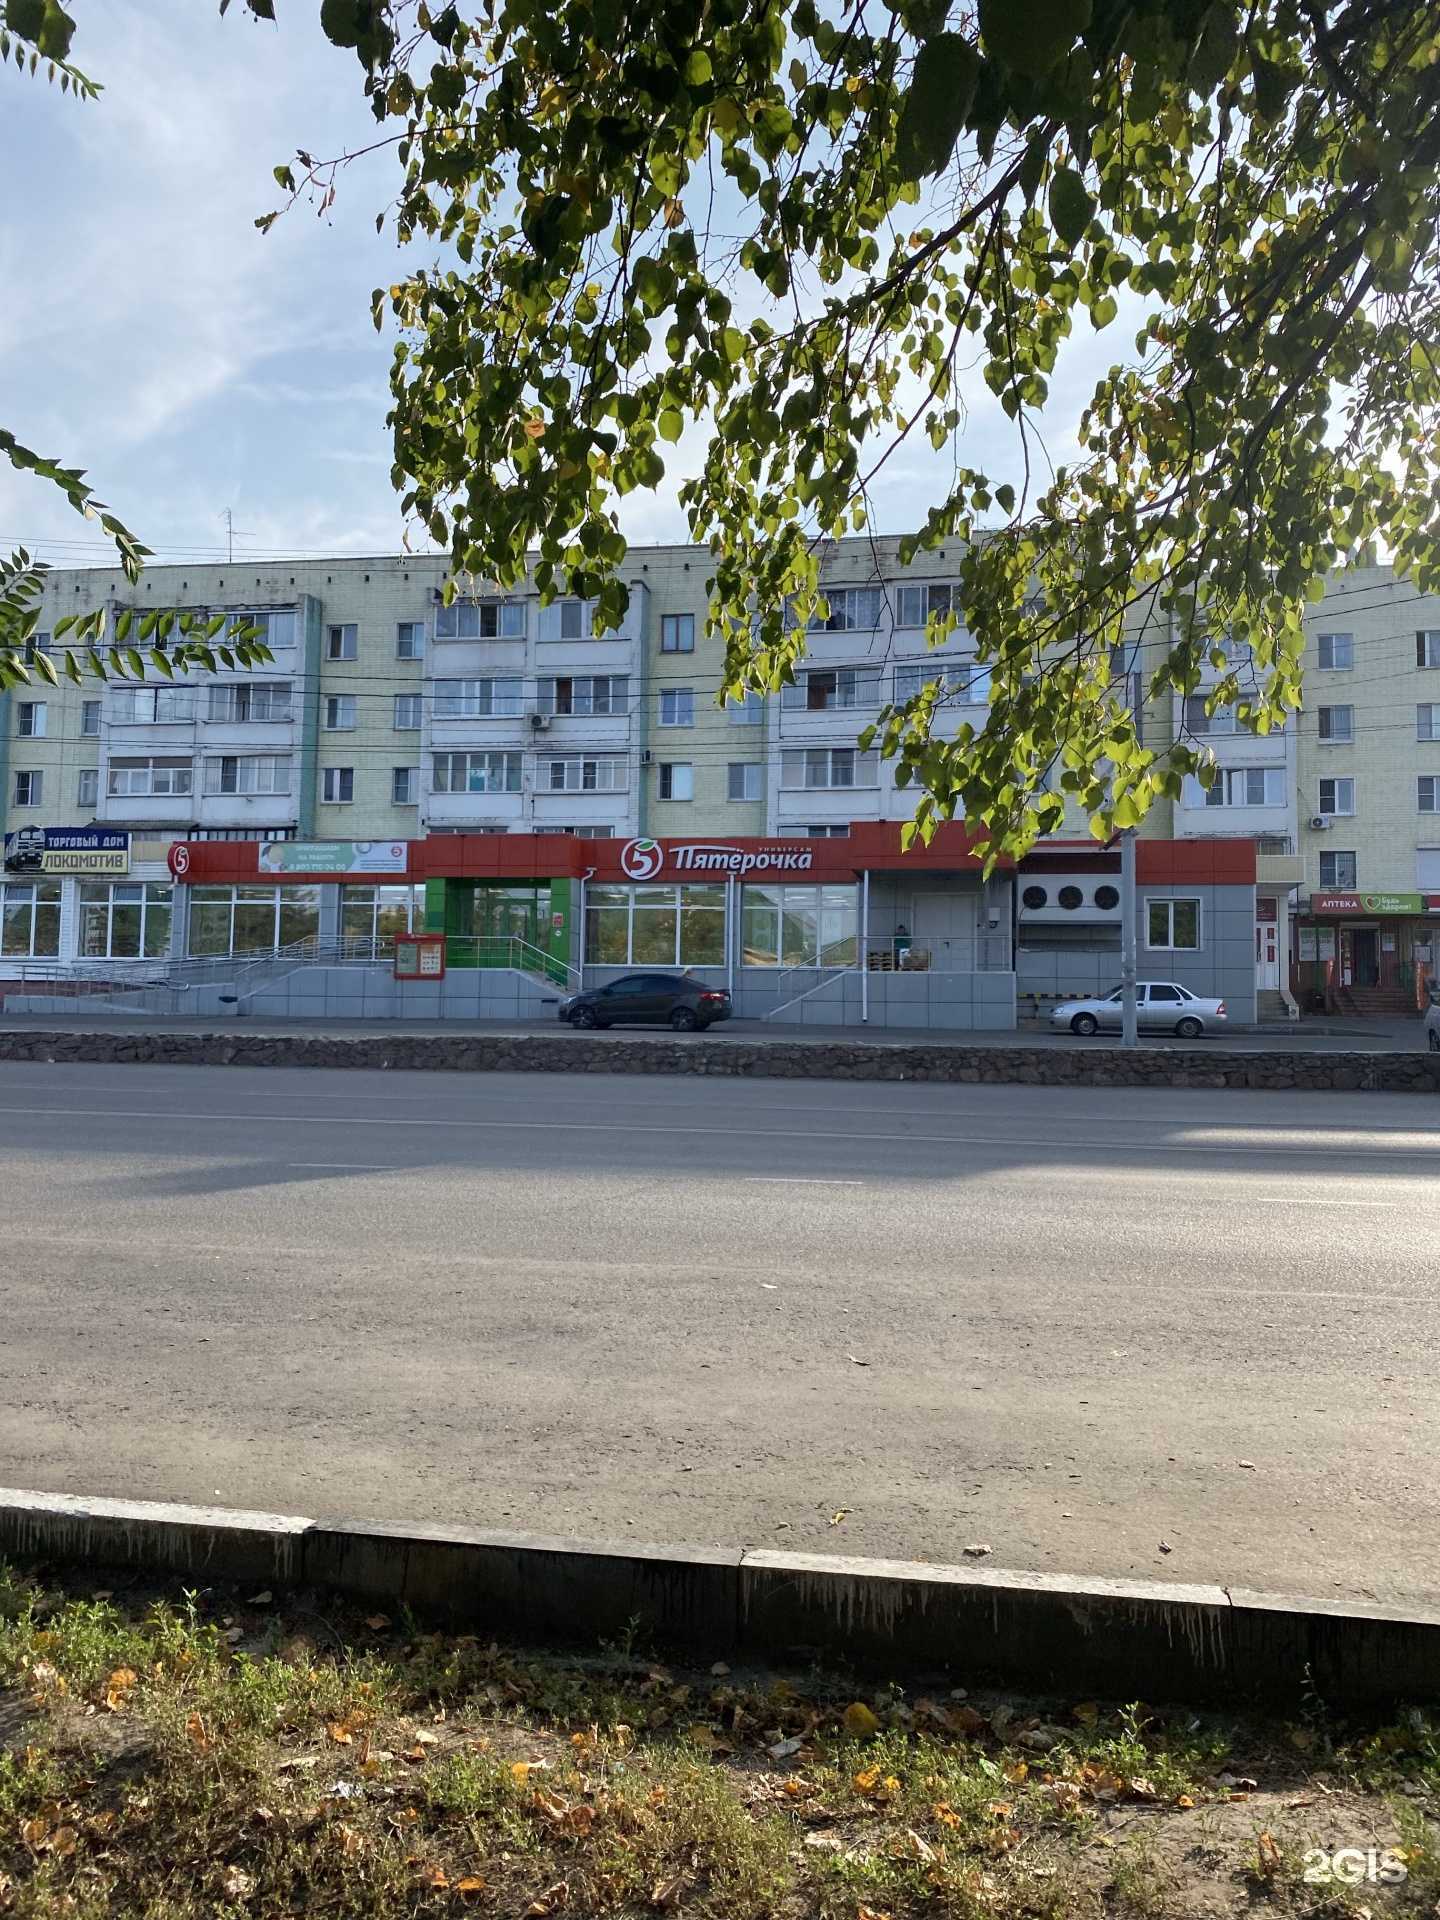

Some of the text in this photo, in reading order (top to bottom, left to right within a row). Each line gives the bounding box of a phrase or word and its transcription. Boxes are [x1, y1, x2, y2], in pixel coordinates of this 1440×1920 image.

[48, 834, 124, 847] ТОРГОВЫЙ ДОМ
[45, 854, 123, 868] ЛОКОМОТИВ
[1321, 900, 1358, 908] АПТЕКА
